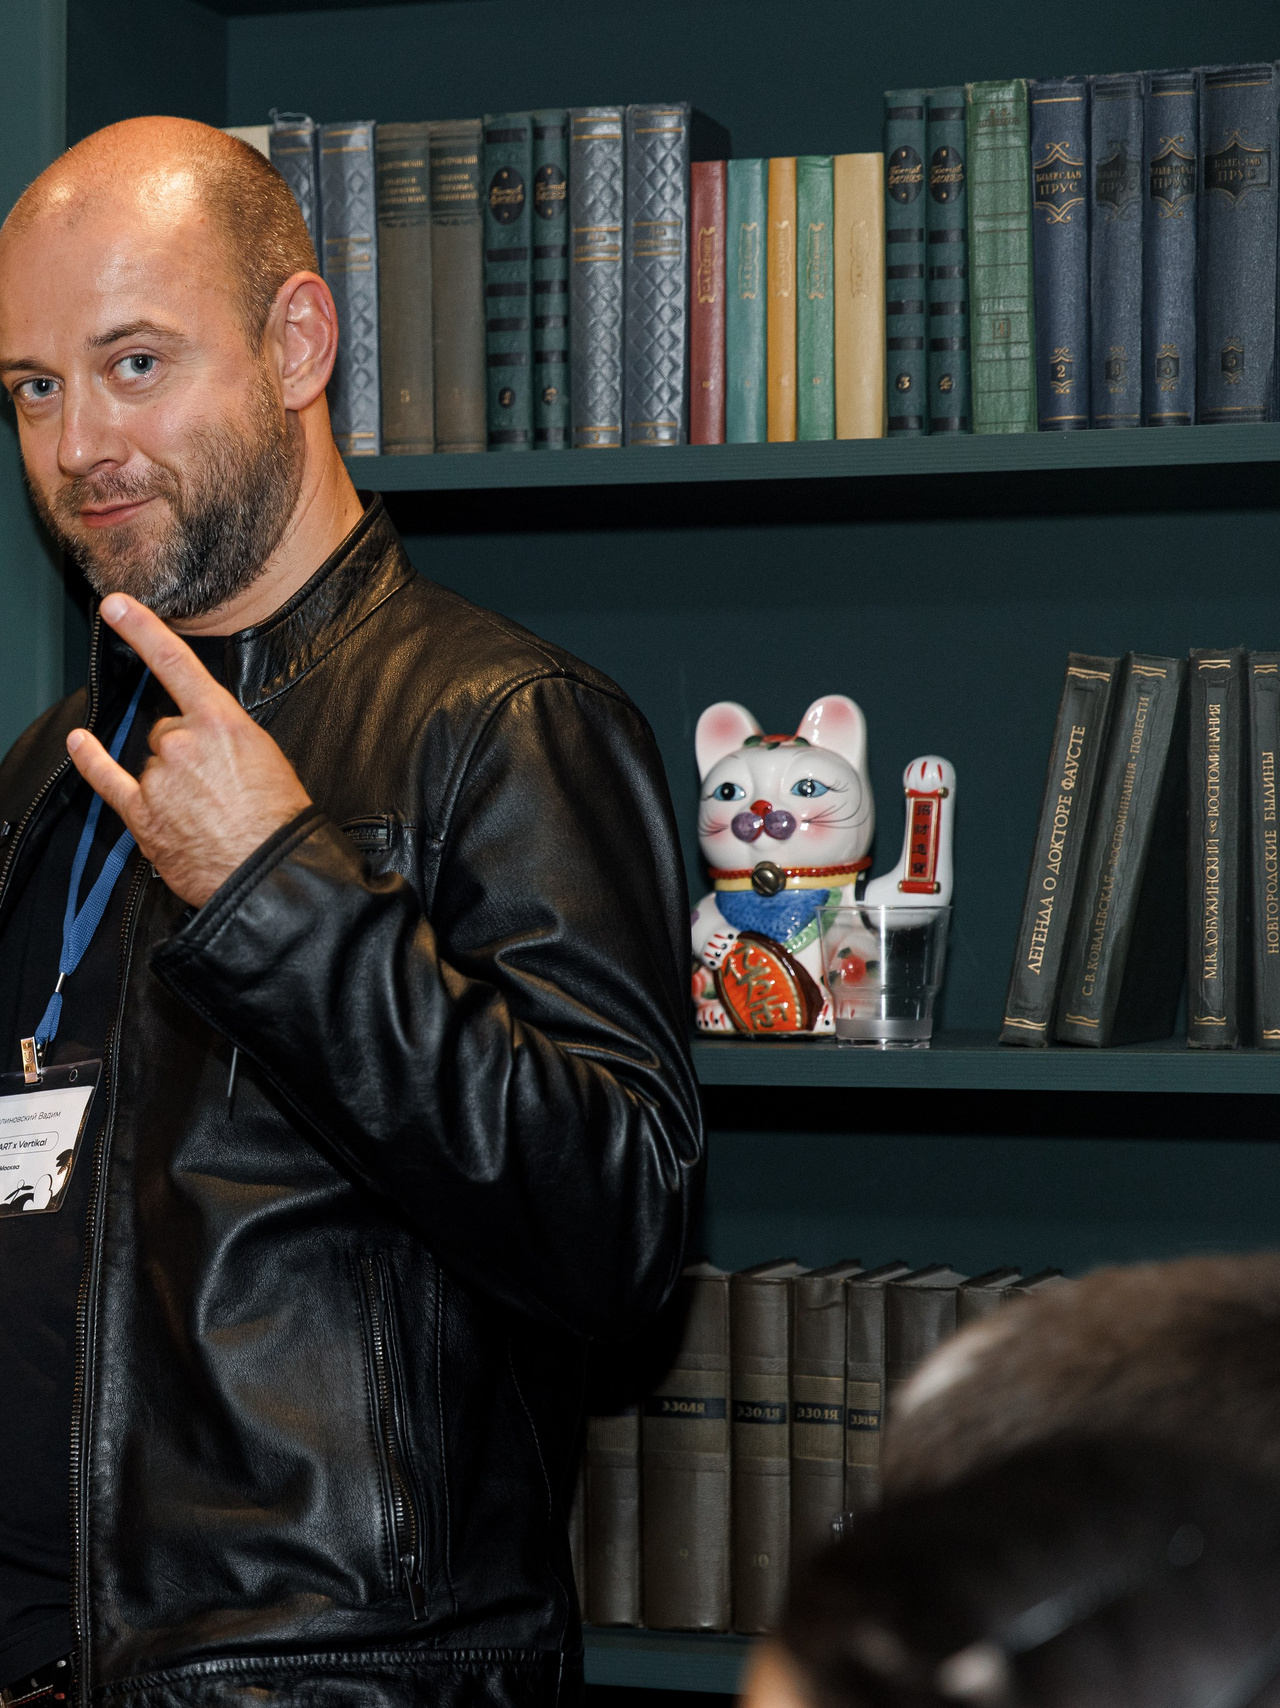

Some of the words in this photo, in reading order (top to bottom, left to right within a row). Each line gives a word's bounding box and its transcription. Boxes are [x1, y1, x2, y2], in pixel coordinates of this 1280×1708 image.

[1036, 170, 1082, 183] БОЛЕСЛАВ
[1153, 175, 1191, 189] ПРУС
[1217, 169, 1257, 182] ПРУС
[1040, 182, 1078, 195] ПРУС
[1056, 364, 1067, 379] 2
[898, 376, 911, 390] 3
[1061, 725, 1086, 790] ФАУСТЕ
[1207, 703, 1221, 817] ВОСПОМИНАНИЯ
[1107, 762, 1137, 866] ВОСПОМИНАНИЯ
[1130, 696, 1150, 754] ПОВЕСТИ
[1262, 751, 1276, 821] БЫЛИНЫ
[1046, 794, 1072, 875] ДОКТОРЕ
[1042, 876, 1057, 891] О
[1264, 829, 1279, 954] НОВГОРОДСКИЕ
[1027, 895, 1055, 975] ЛЕГЕНДА
[38, 1111, 61, 1121] Вадим
[19, 1138, 47, 1148] Vertikal
